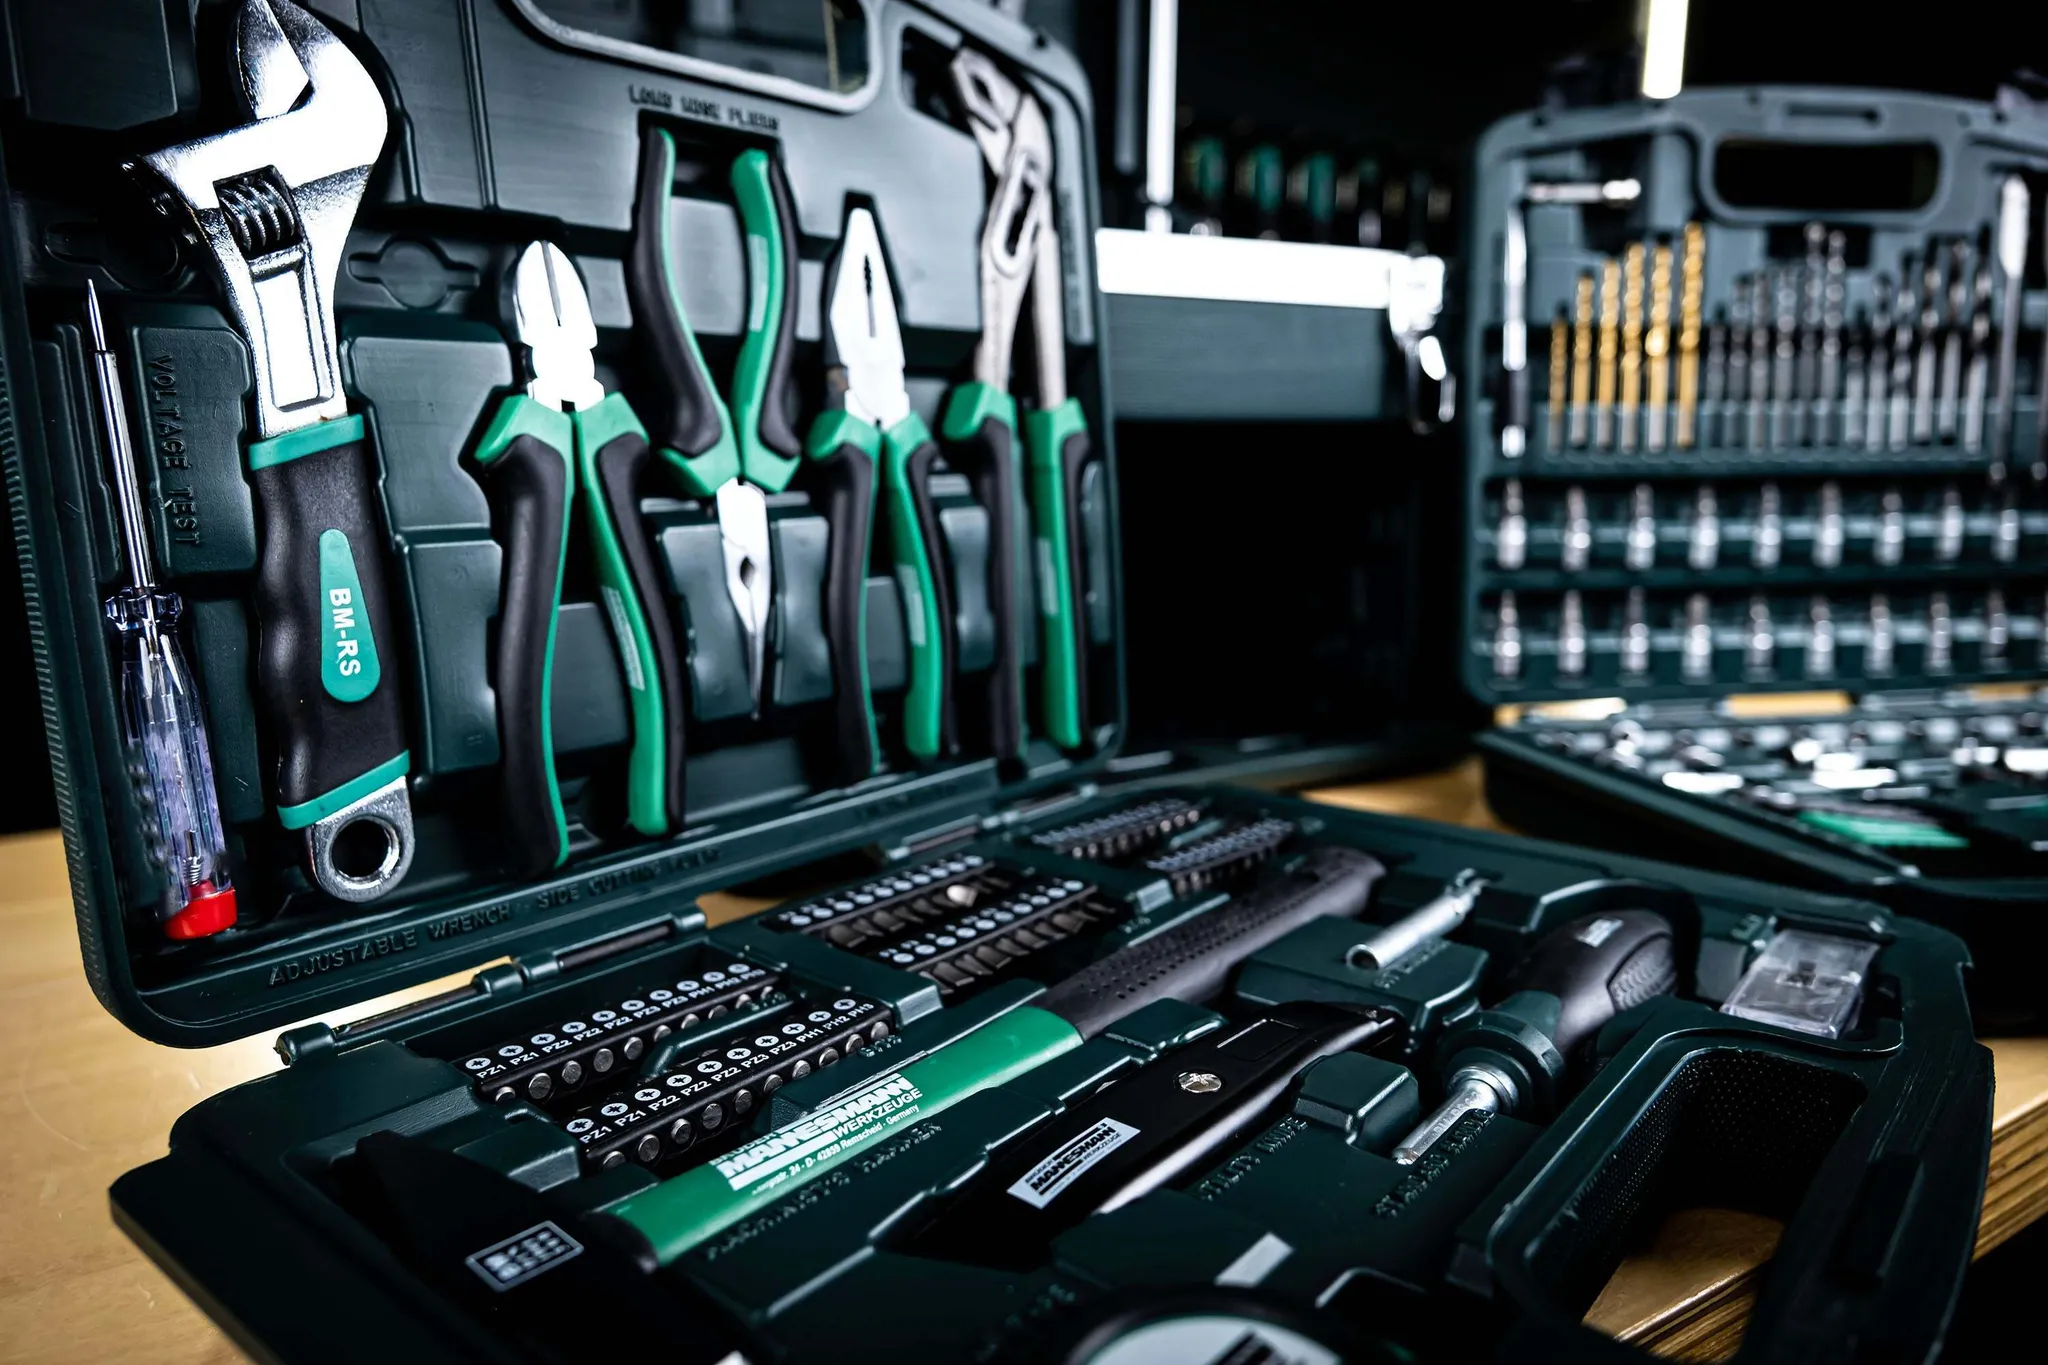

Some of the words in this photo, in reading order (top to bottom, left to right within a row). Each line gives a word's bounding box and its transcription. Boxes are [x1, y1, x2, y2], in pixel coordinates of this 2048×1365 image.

[149, 354, 189, 470] VOLTAGE
[169, 484, 200, 546] TEST
[328, 588, 362, 677] BM-RS
[538, 883, 581, 909] SIDE
[269, 928, 418, 987] ADJUSTABLE
[428, 903, 512, 940] WRENCH
[476, 1064, 507, 1079] PZ1
[510, 1051, 539, 1065] PZ1
[541, 1039, 573, 1054] PZ2
[573, 1027, 604, 1042] PZ2
[603, 1016, 633, 1030] PZ2
[633, 1005, 661, 1019] PZ3
[661, 995, 689, 1008] PZ3
[688, 986, 715, 999] PH1
[579, 1126, 612, 1144] PZ1
[614, 1109, 647, 1127] PZ1
[648, 1094, 681, 1111] PZ2
[680, 1080, 712, 1096] PZ2
[711, 1067, 742, 1082] PZ2
[740, 1053, 770, 1068] PZ3
[768, 1040, 797, 1055] PZ3
[796, 1028, 824, 1043] PH1
[822, 1015, 850, 1031] PH2
[847, 1003, 875, 1017] PH3
[789, 1163, 800, 1176] 24
[840, 1122, 883, 1149] Remscheid
[886, 1104, 920, 1125] Germany
[833, 1088, 923, 1138] WERKZEUGE
